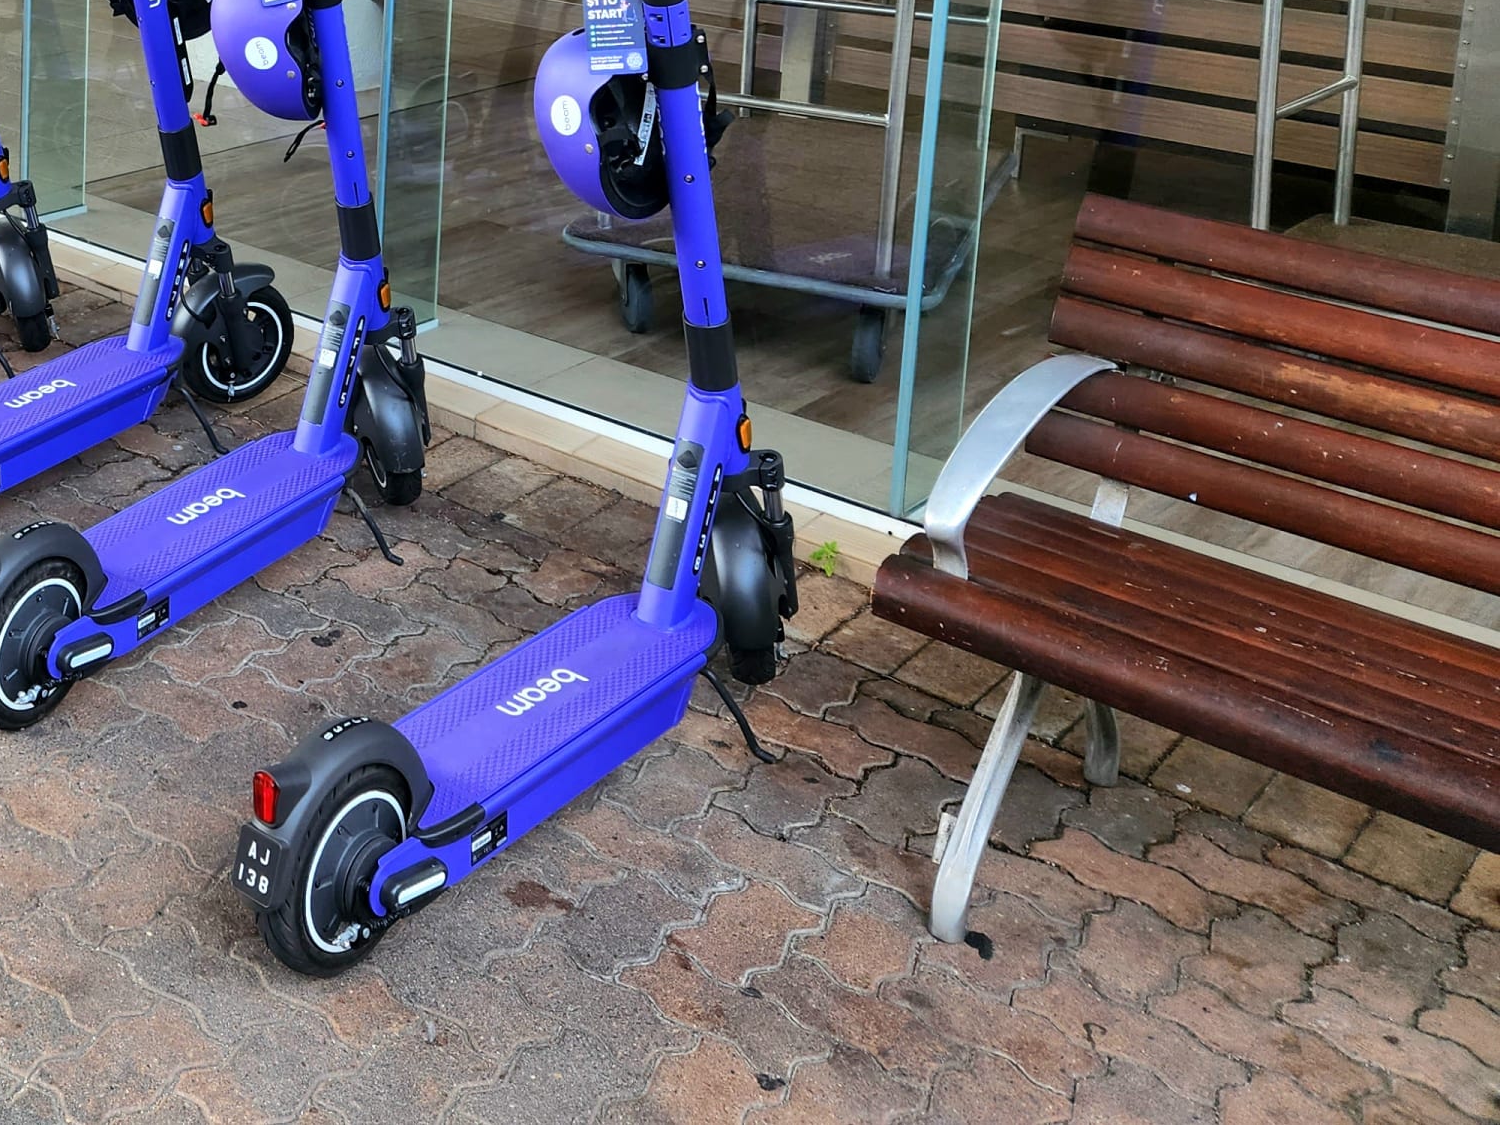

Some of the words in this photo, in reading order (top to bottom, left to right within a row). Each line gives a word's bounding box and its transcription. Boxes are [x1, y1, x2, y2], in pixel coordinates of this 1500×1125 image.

[587, 8, 623, 20] START
[562, 100, 572, 131] beam
[4, 379, 77, 409] beam
[167, 488, 246, 525] beam
[496, 668, 590, 716] beam
[248, 840, 271, 865] AJ
[238, 863, 269, 894] 138
